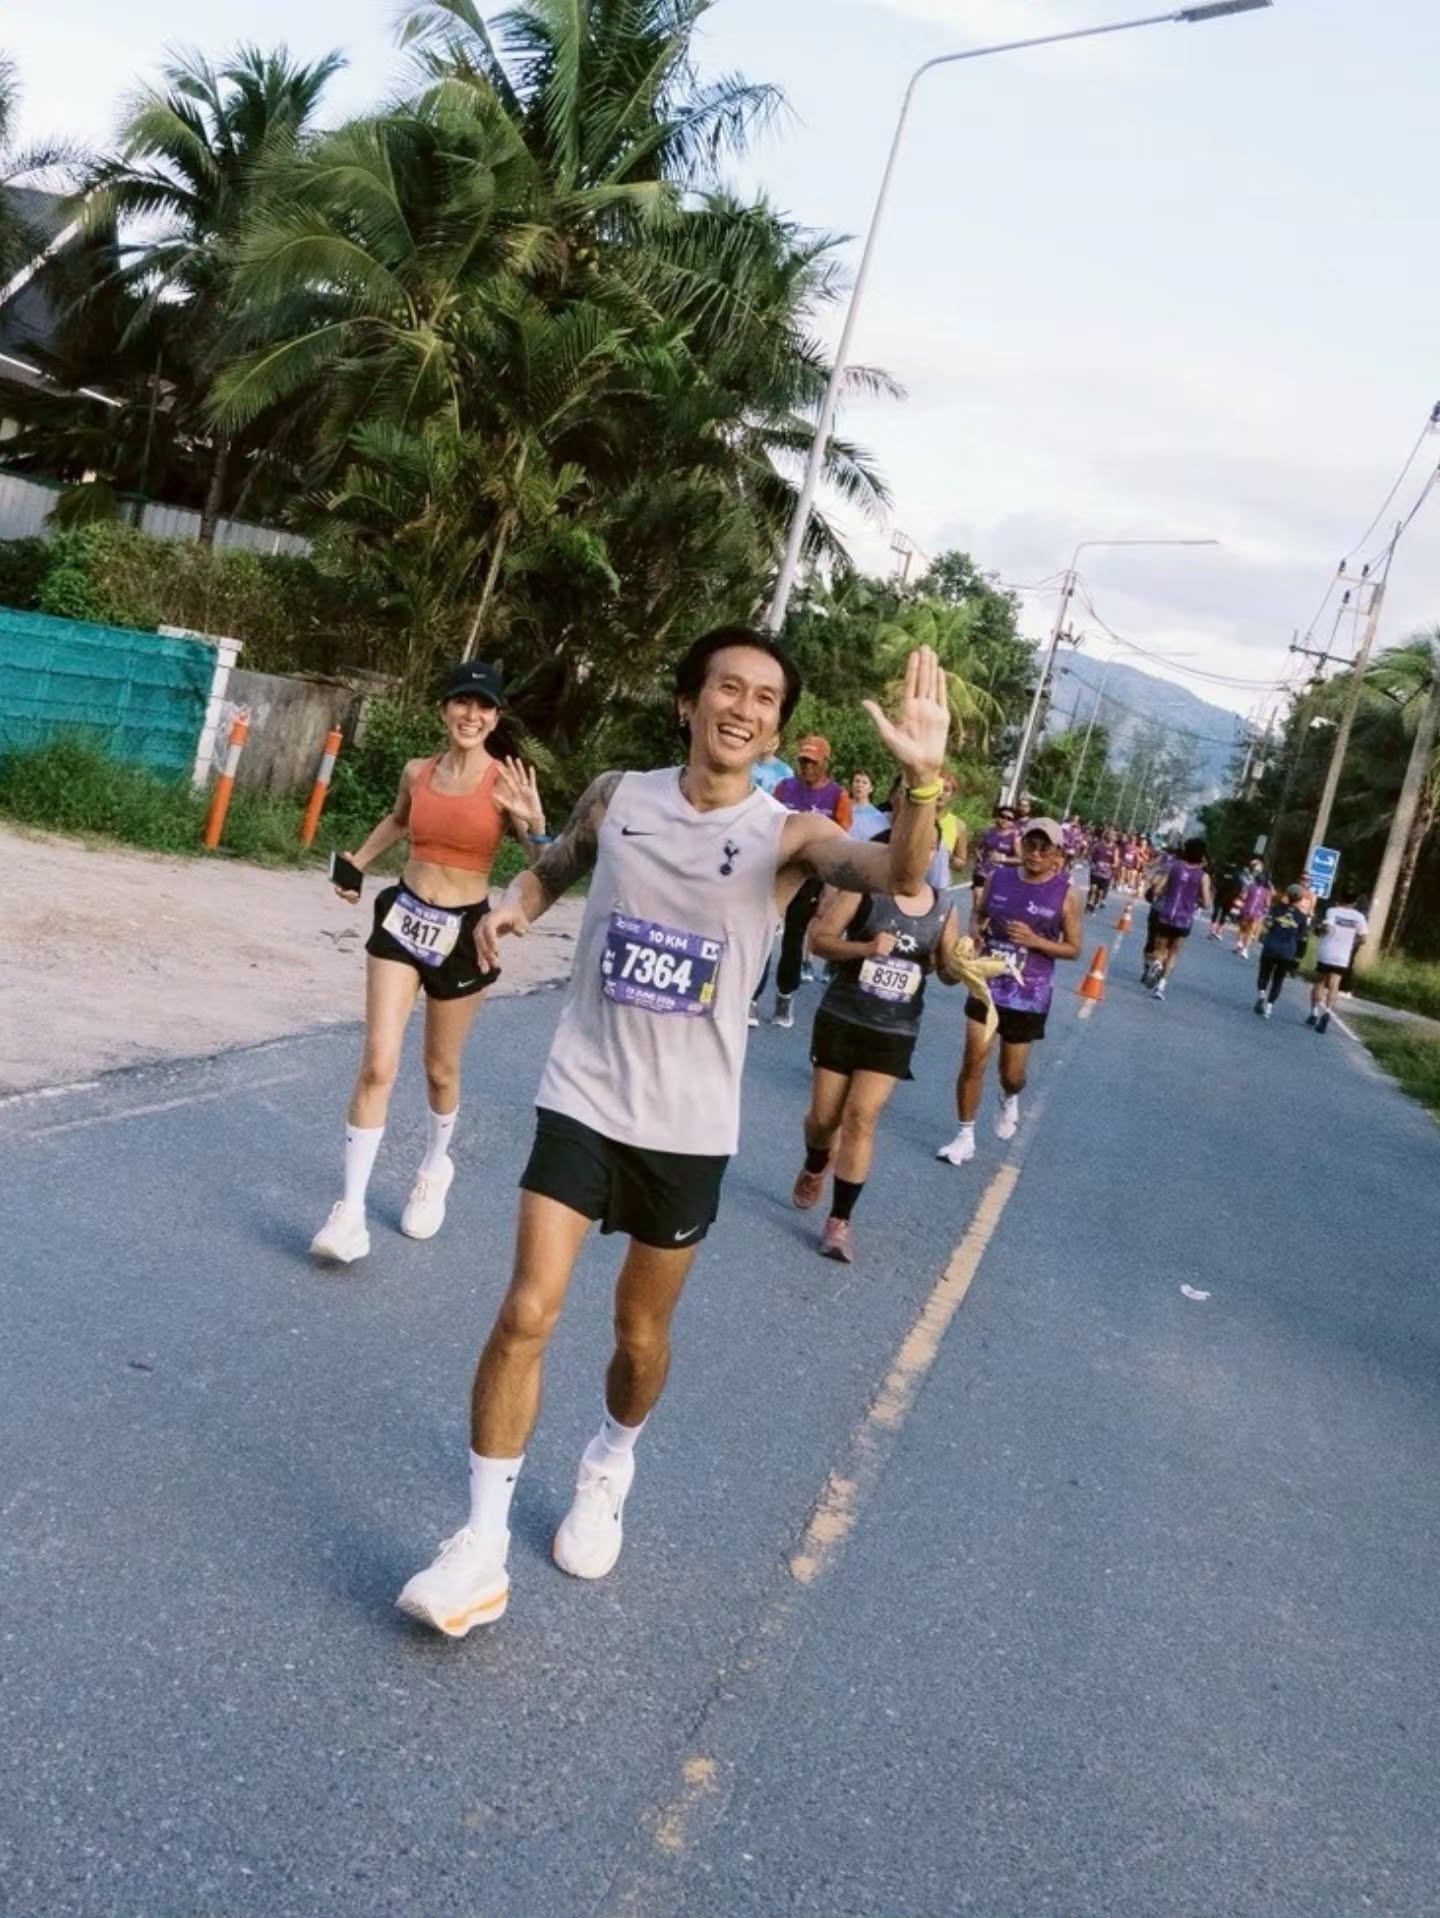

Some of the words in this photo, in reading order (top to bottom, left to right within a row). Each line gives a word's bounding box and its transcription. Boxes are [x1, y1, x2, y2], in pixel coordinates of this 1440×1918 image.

[401, 915, 441, 947] 8417
[648, 929, 663, 943] 10
[665, 933, 688, 950] KM
[620, 943, 694, 995] 7364
[872, 967, 908, 989] 8379
